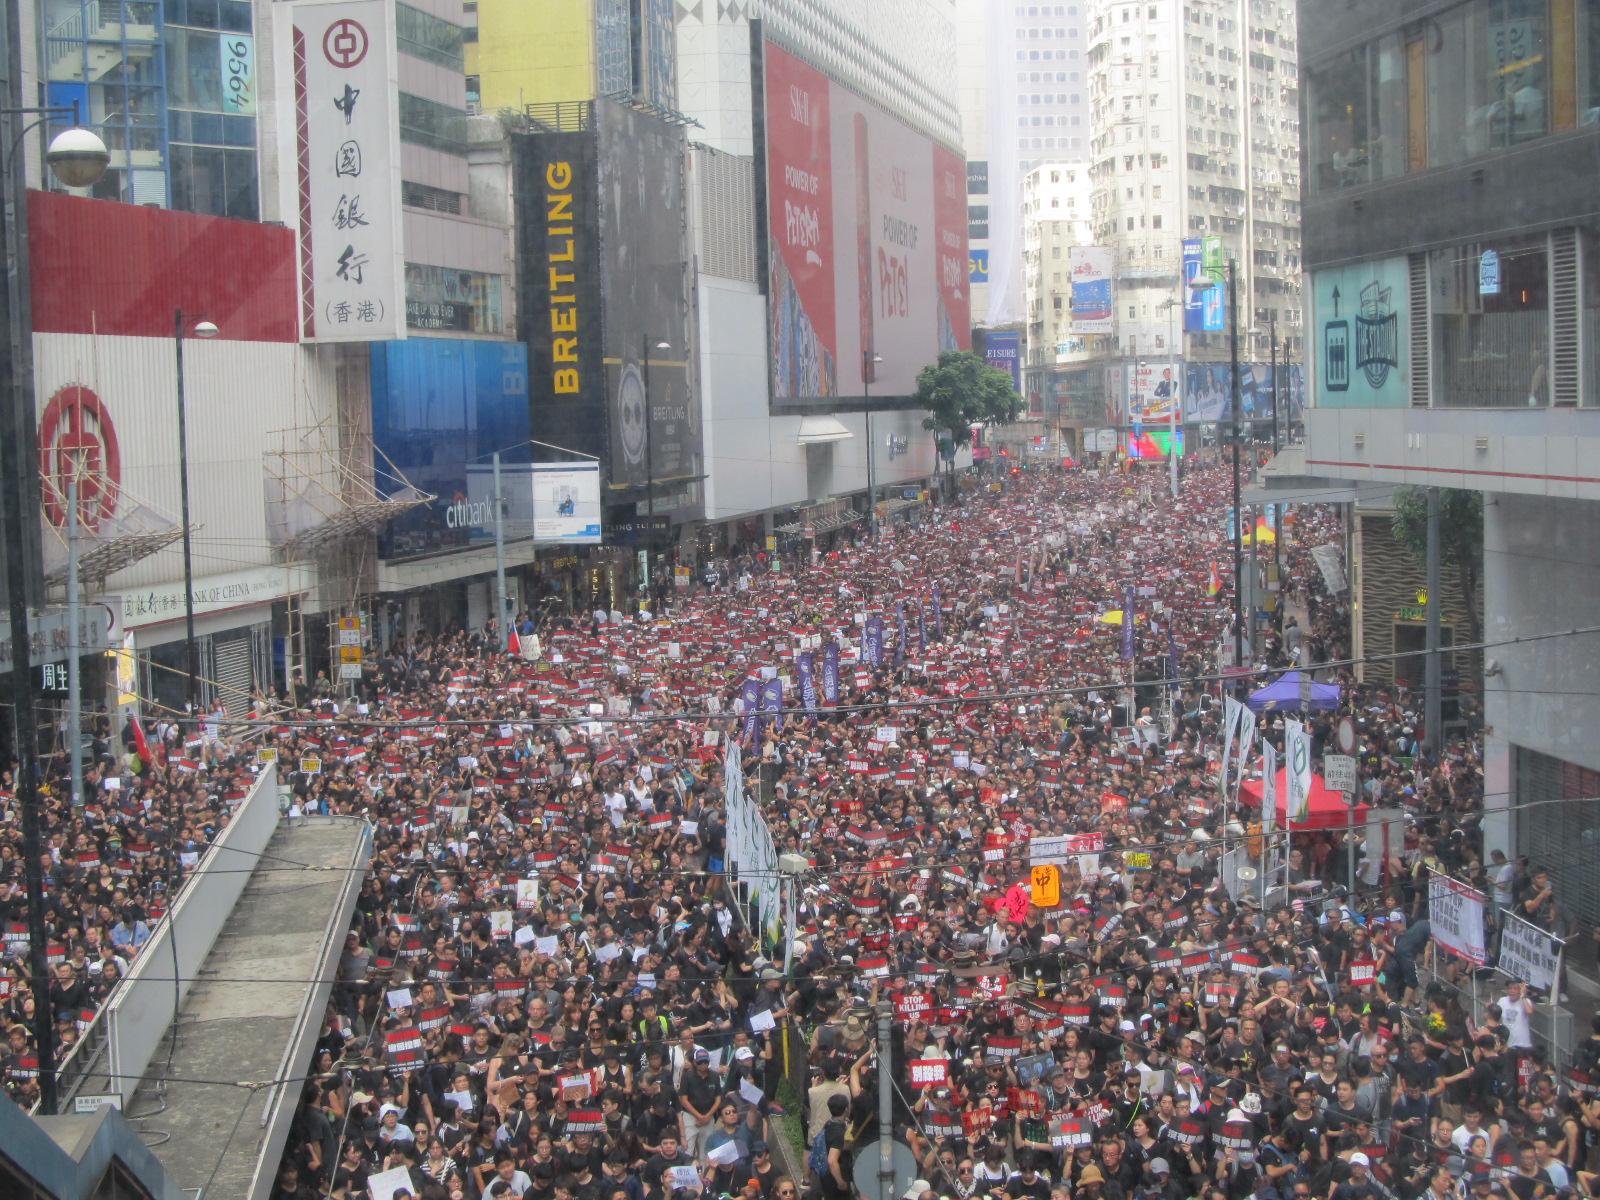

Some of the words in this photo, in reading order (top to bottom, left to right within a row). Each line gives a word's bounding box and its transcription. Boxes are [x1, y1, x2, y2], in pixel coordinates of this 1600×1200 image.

[227, 41, 249, 108] 9564
[332, 83, 370, 284] 中國銀行
[785, 165, 809, 192] POWER
[810, 177, 818, 195] OF
[883, 214, 908, 247] POWER
[546, 162, 580, 394] BREITLING
[325, 299, 385, 325] (香港)
[406, 303, 419, 315] AKE
[653, 406, 686, 421] BREITLING
[446, 494, 495, 528] citibank
[209, 588, 222, 601] OF
[222, 582, 250, 599] CHINA
[1036, 874, 1051, 896] 中
[898, 1003, 930, 1012] KILLING
[903, 995, 924, 1004] STOP
[1051, 1112, 1074, 1121] STOP
